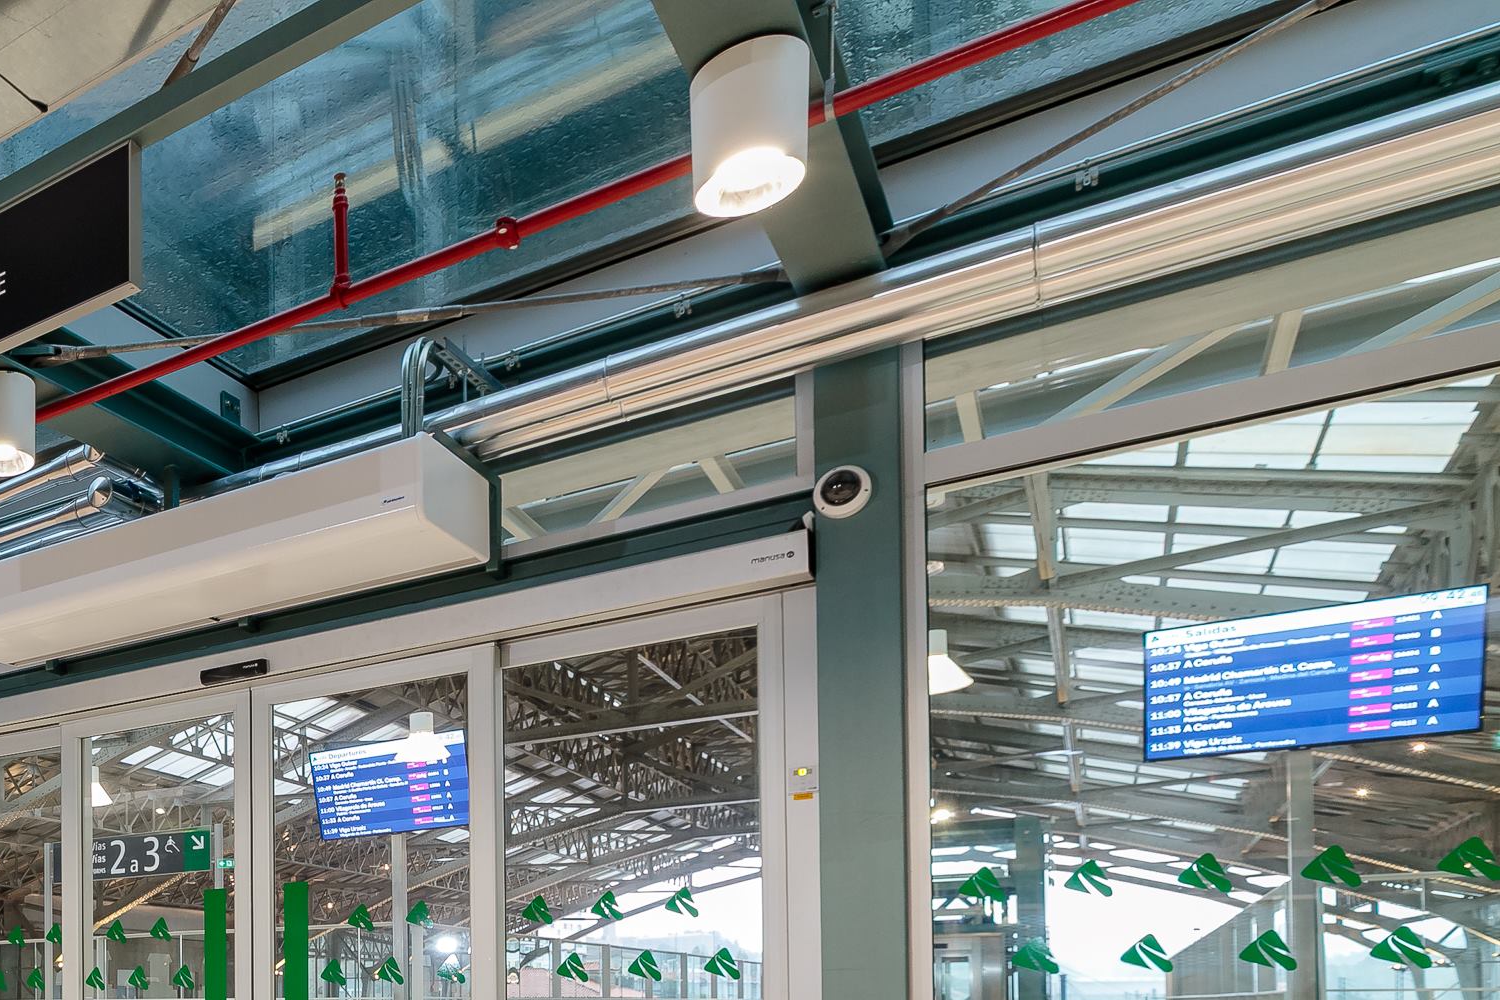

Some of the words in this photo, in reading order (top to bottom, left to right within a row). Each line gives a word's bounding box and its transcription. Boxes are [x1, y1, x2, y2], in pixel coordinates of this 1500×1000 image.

[750, 552, 785, 564] manusa
[1430, 610, 1443, 619] A
[1186, 625, 1237, 638] Salidas
[1183, 660, 1192, 669] A
[1193, 655, 1233, 668] Coruña
[1183, 671, 1221, 685] Madrid
[1183, 692, 1192, 701] A
[1193, 688, 1233, 700] Coruña
[1428, 663, 1441, 673] A
[1428, 681, 1440, 690] A
[1183, 725, 1192, 733] A
[1193, 720, 1233, 732] Coruña
[1427, 698, 1439, 708] A
[1426, 716, 1438, 725] A
[329, 749, 367, 760] Departures
[336, 771, 354, 780] Coruña
[333, 782, 350, 791] Madrid
[338, 793, 357, 802] Coruña
[342, 814, 360, 822] Coruña
[110, 839, 126, 875] 2
[129, 859, 139, 873] a
[143, 836, 160, 872] 3
